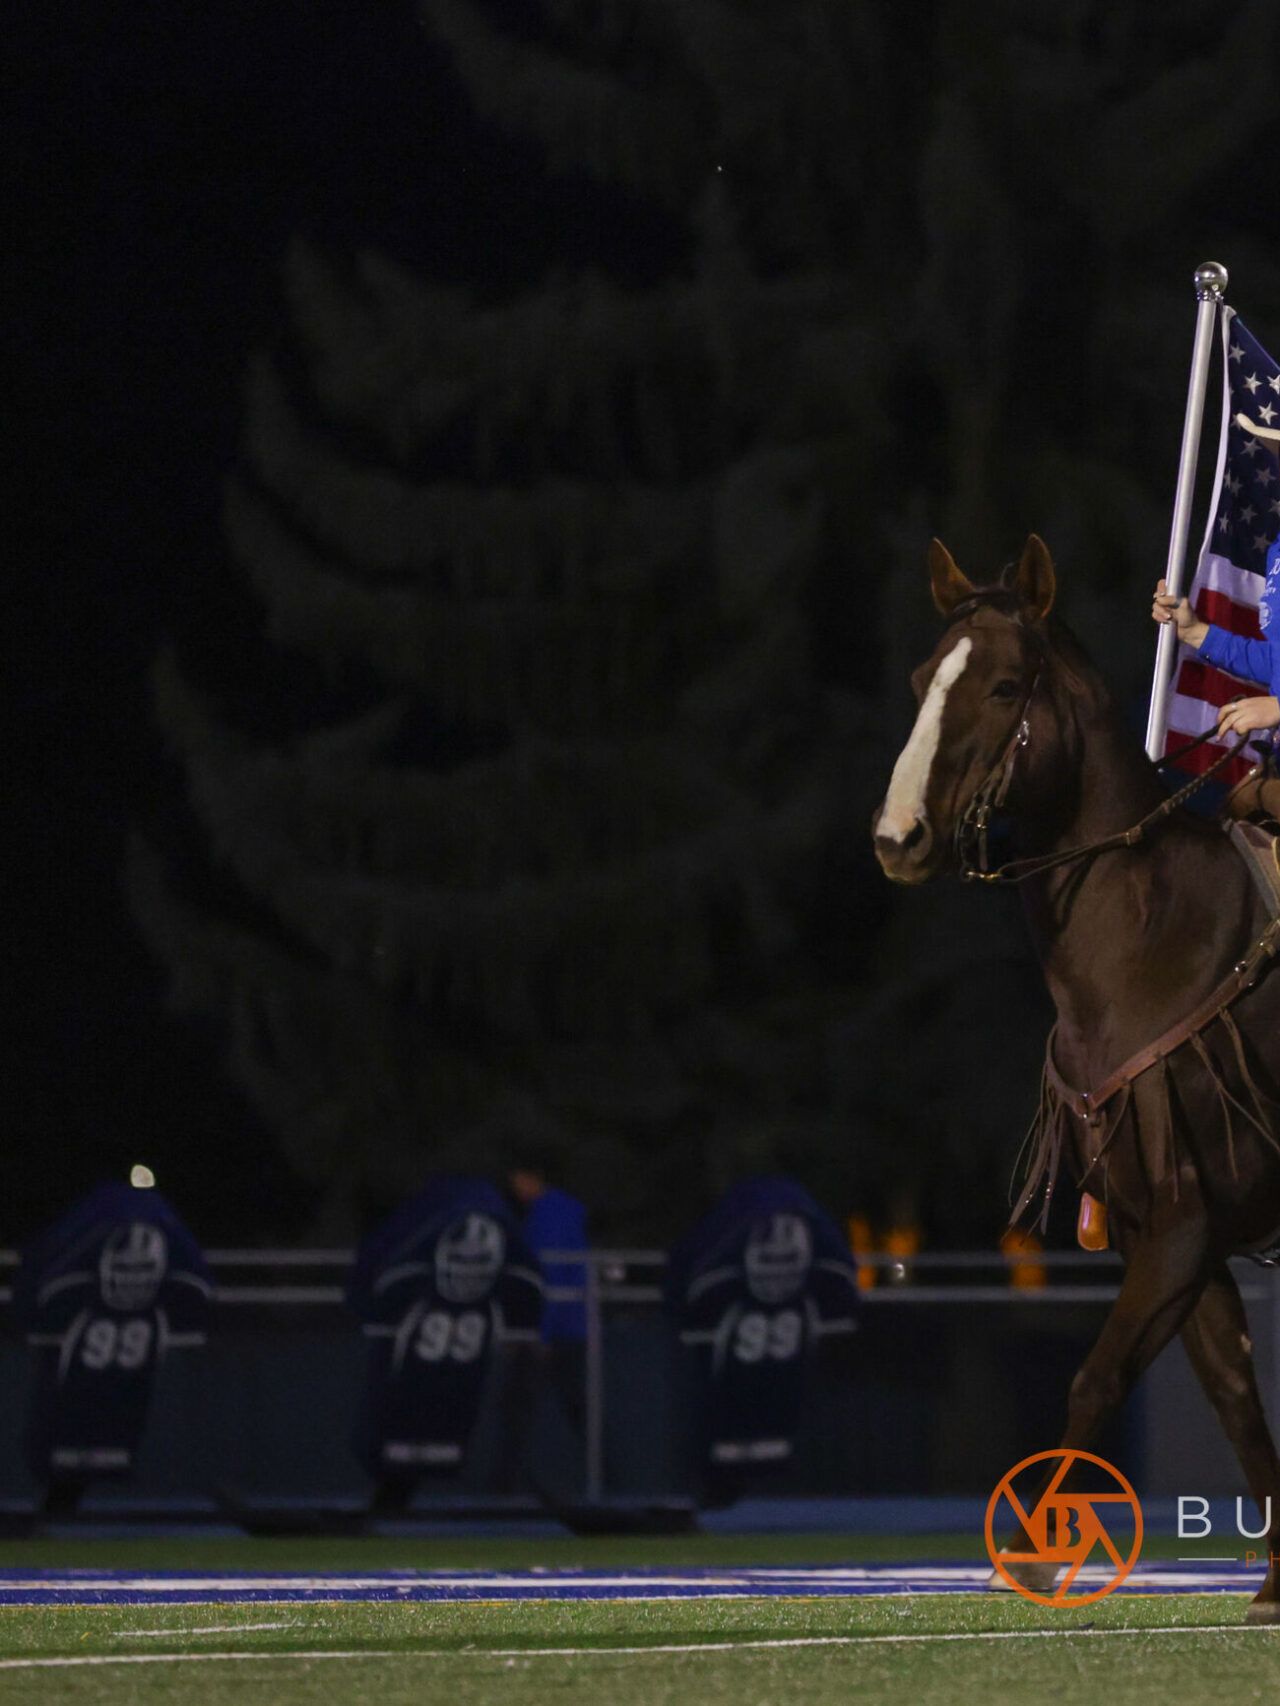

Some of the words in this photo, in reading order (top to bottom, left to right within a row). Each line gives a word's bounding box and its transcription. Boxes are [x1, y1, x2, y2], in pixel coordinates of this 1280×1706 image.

[81, 1318, 151, 1370] 99
[414, 1311, 486, 1362] 99
[733, 1310, 801, 1362] 99
